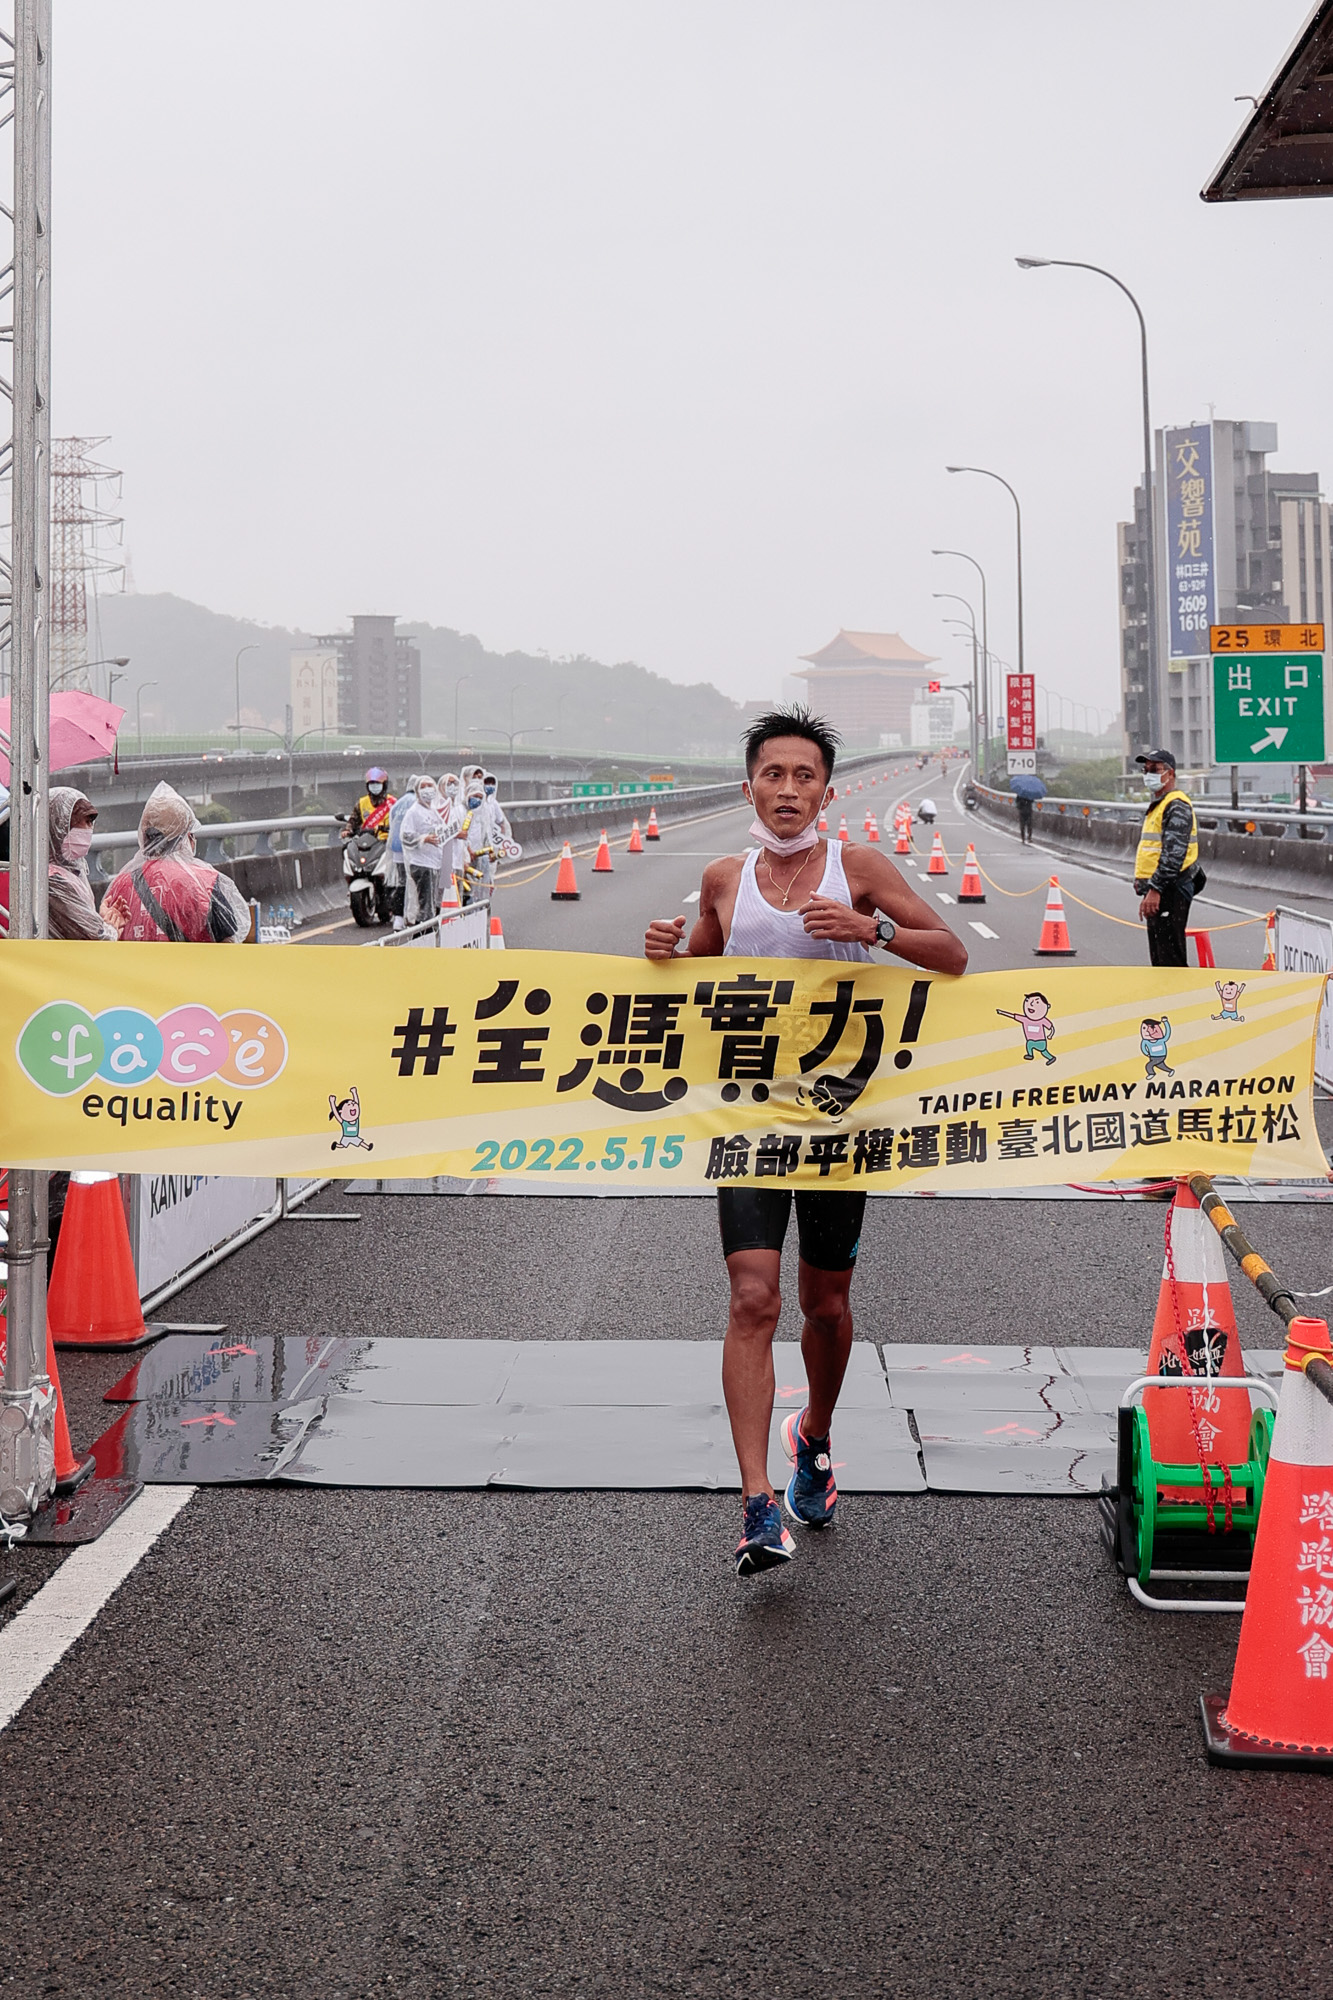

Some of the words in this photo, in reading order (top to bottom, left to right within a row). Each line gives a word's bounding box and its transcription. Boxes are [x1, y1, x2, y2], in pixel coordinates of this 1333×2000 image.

[1175, 439, 1205, 558] 交響苑
[1178, 595, 1207, 613] 2609
[1179, 613, 1208, 631] 1616
[1217, 630, 1249, 648] 25
[1228, 663, 1308, 691] 出口
[1238, 697, 1298, 717] EXIT
[919, 1091, 1001, 1115] TAIPEI
[1012, 1082, 1137, 1108] FREEWAY
[1145, 1075, 1296, 1100] MARATHON
[82, 1091, 243, 1130] equality
[470, 1135, 686, 1171] 2022.5.15
